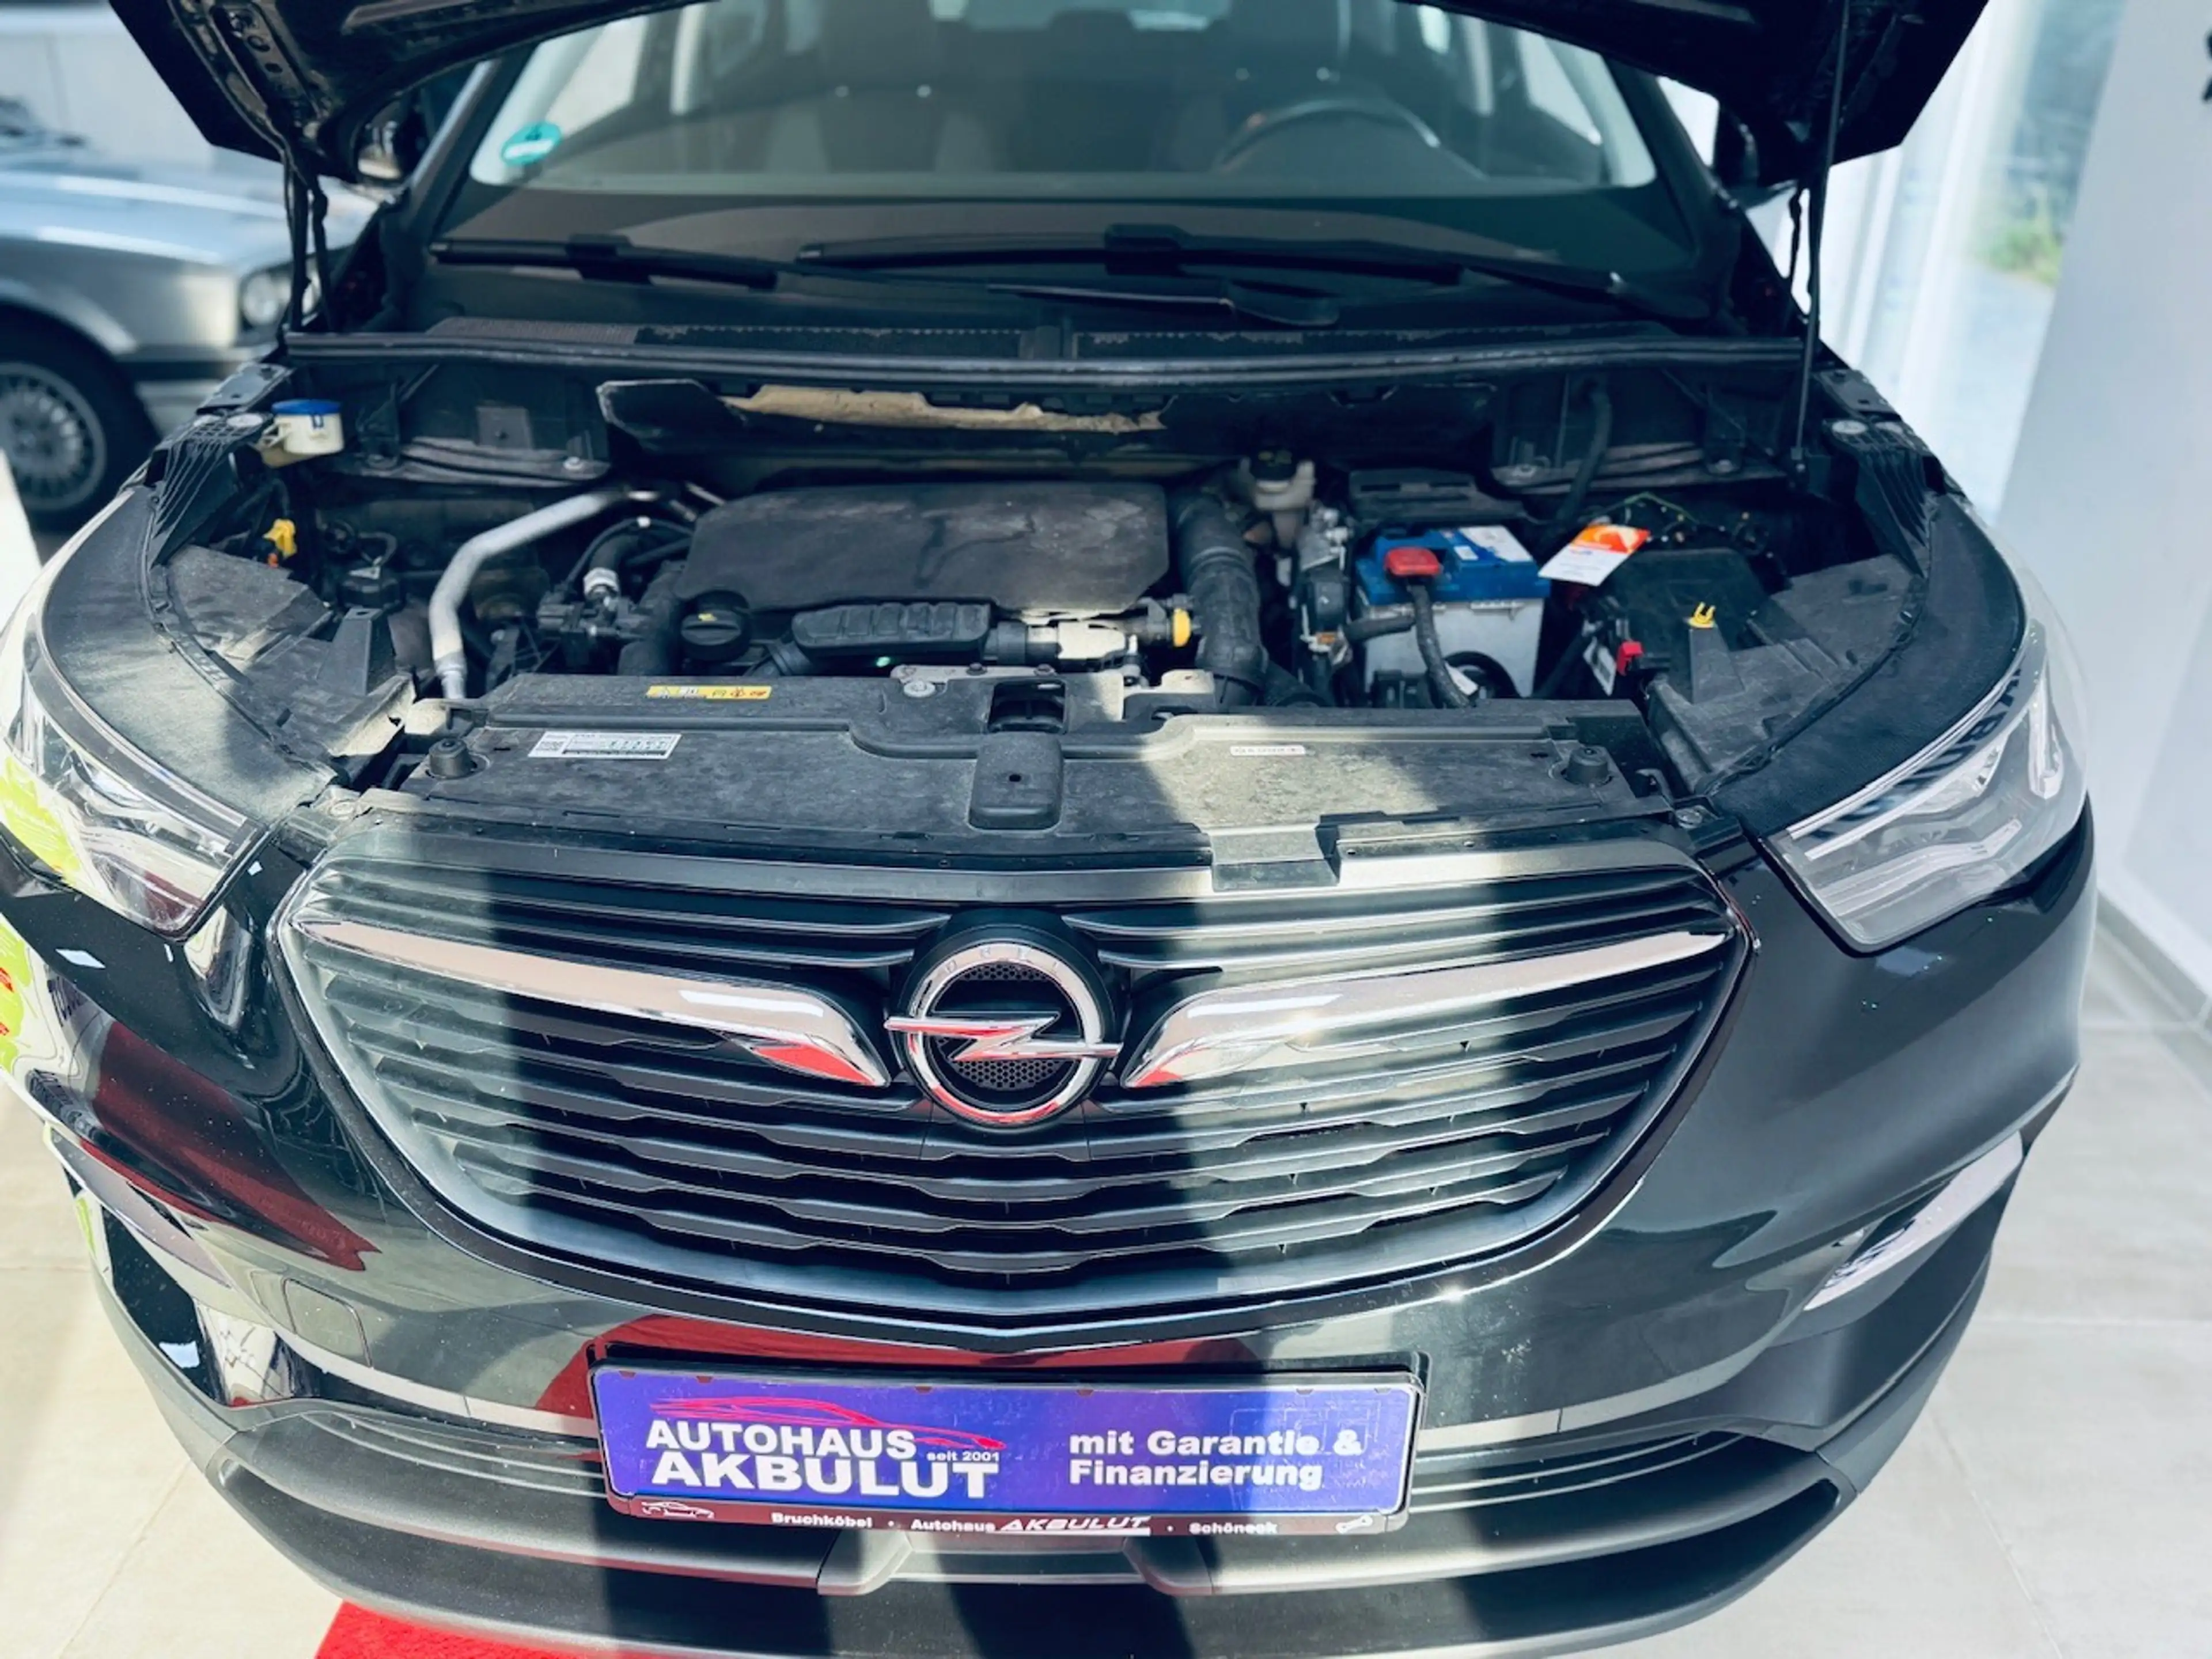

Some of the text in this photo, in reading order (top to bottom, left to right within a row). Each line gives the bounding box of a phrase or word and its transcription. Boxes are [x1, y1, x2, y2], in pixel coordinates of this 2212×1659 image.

[646, 1420, 917, 1460] AUTOHAUS
[1070, 1429, 1362, 1456] mit Garantie &
[927, 1450, 999, 1461] seit 2001
[652, 1451, 999, 1498] AKBULUT
[1070, 1459, 1323, 1491] Finanzierung
[771, 1512, 1279, 1535] Bruchköbel Autohaus AKBULUT Schöneck
